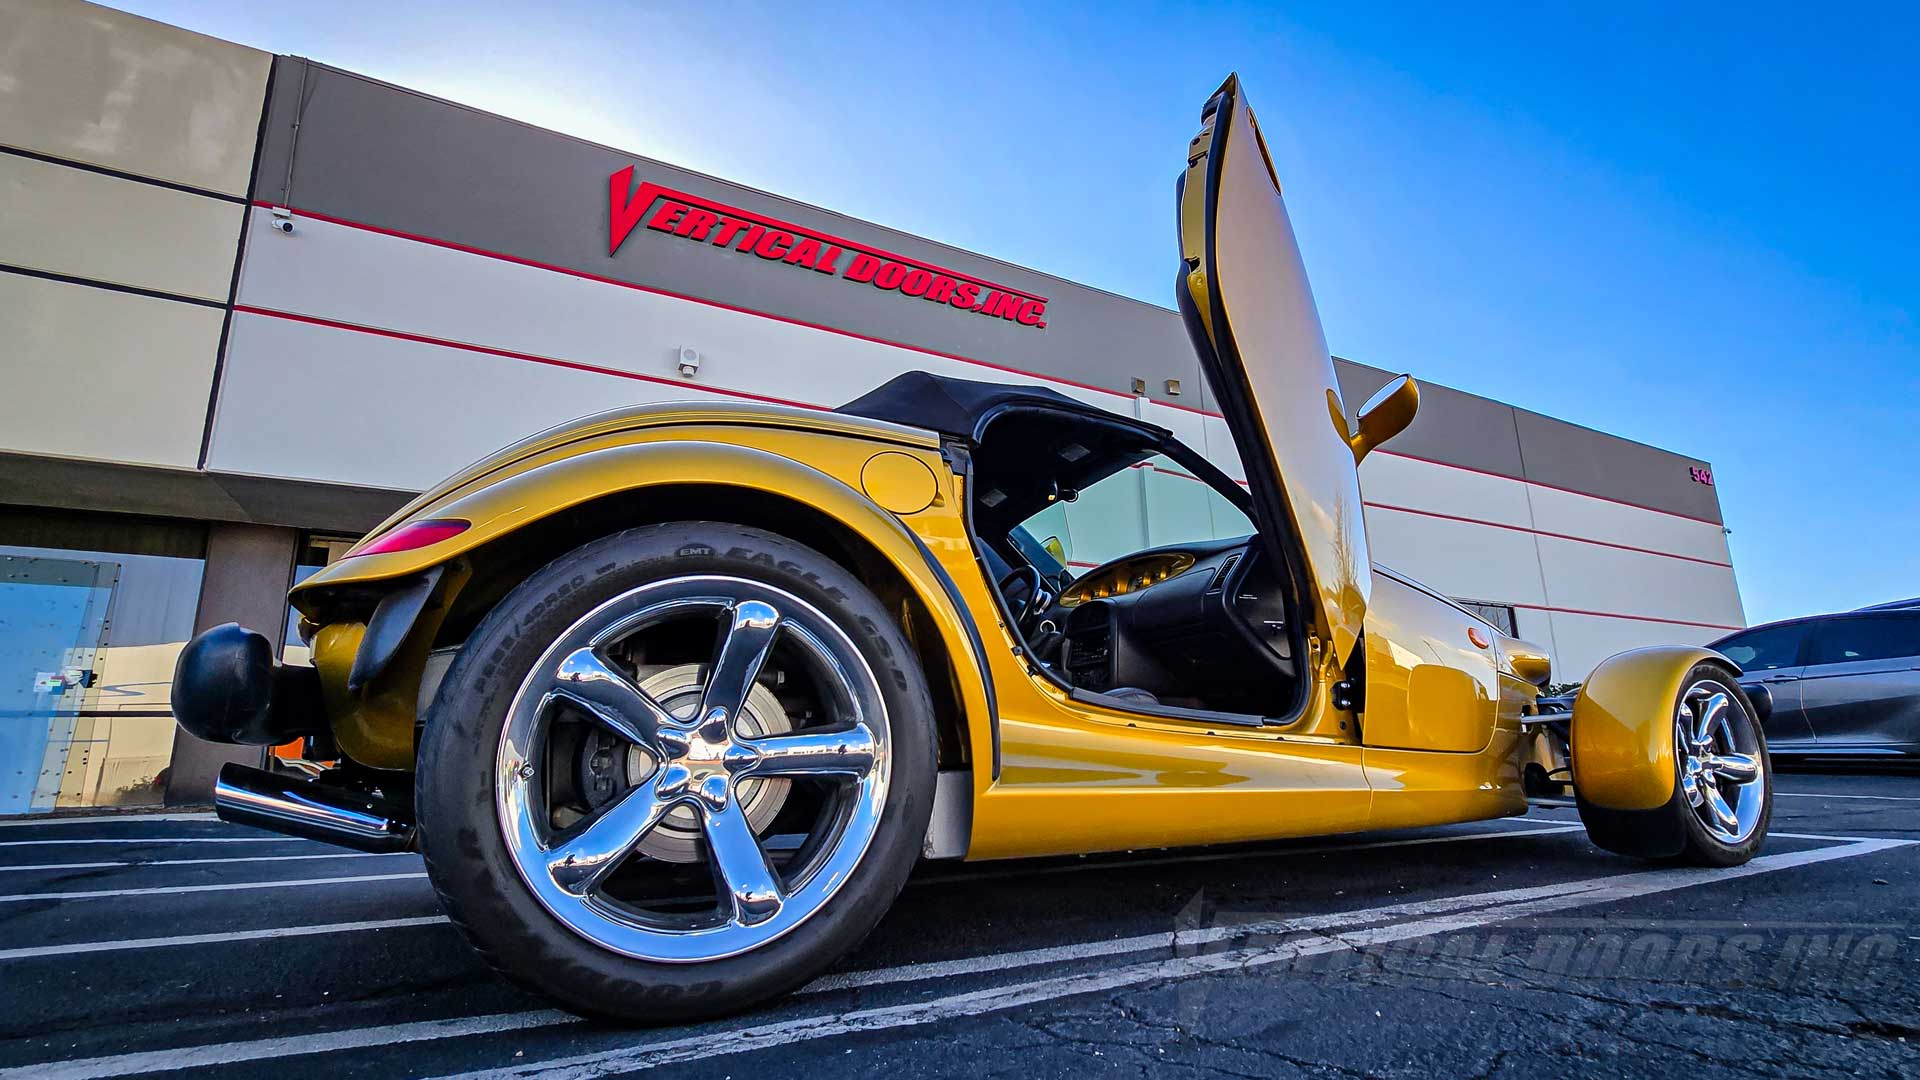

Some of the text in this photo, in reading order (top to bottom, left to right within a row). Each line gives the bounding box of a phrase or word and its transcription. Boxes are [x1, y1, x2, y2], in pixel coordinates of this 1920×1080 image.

[609, 164, 843, 275] VERTICAL
[1689, 466, 1713, 486] 542
[679, 547, 711, 556] EMT
[723, 546, 849, 603] EAGLE
